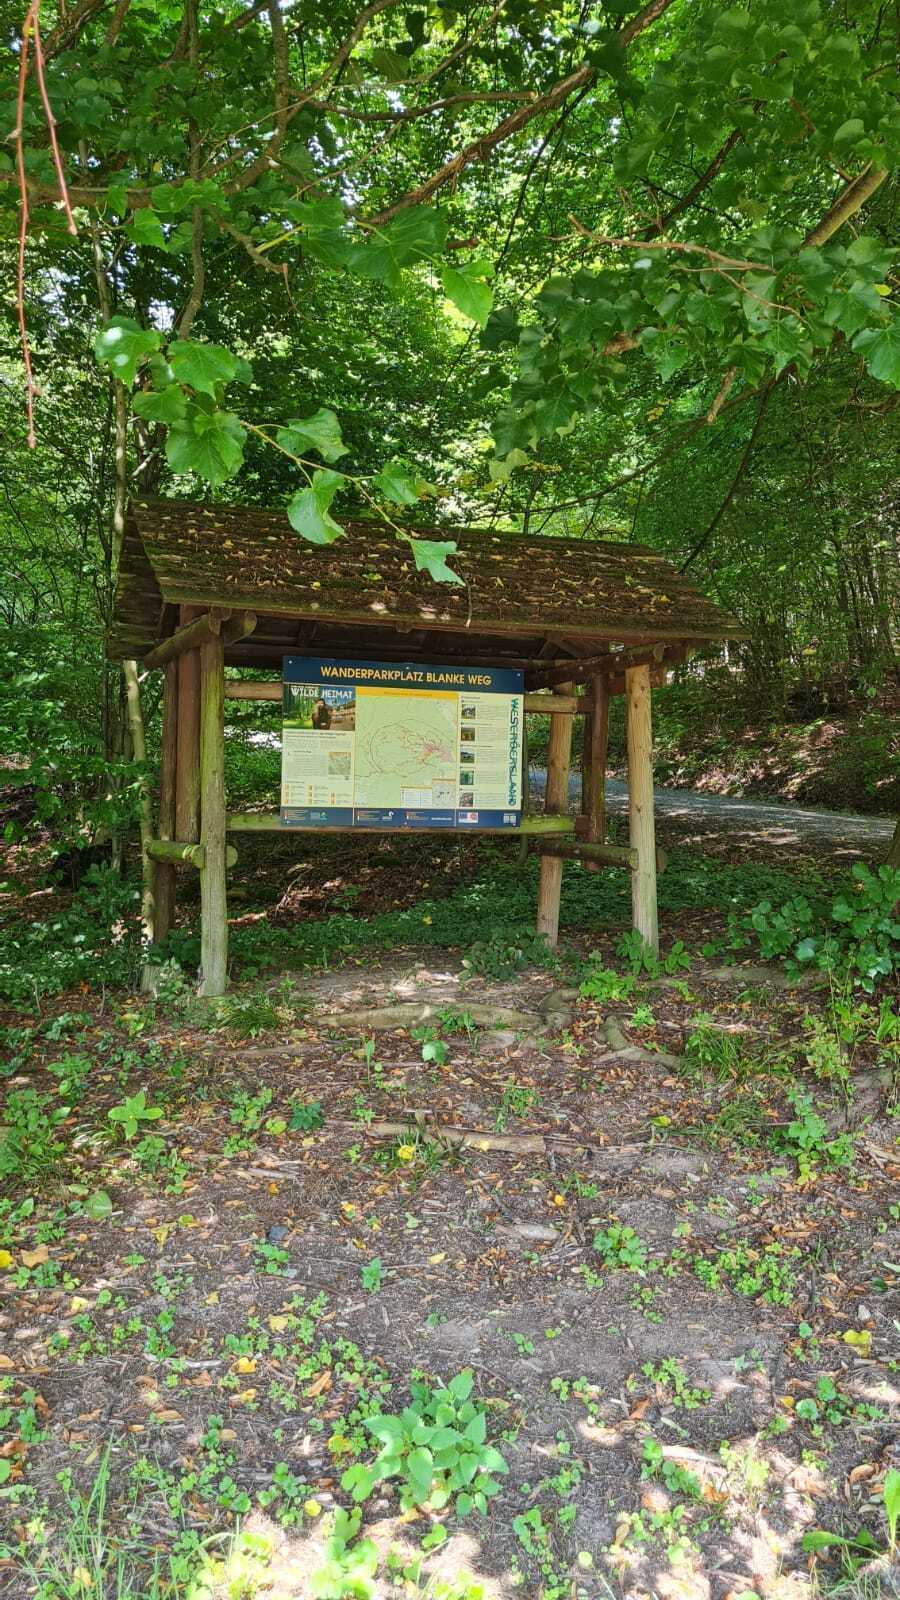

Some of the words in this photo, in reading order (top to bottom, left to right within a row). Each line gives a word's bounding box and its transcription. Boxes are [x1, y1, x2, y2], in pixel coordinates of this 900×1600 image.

[320, 666, 424, 682] WANDERPARKPLATZ
[426, 672, 465, 685] BLANKE
[468, 674, 492, 686] WEG
[290, 686, 319, 697] WILDE
[321, 688, 353, 699] HEIMAT
